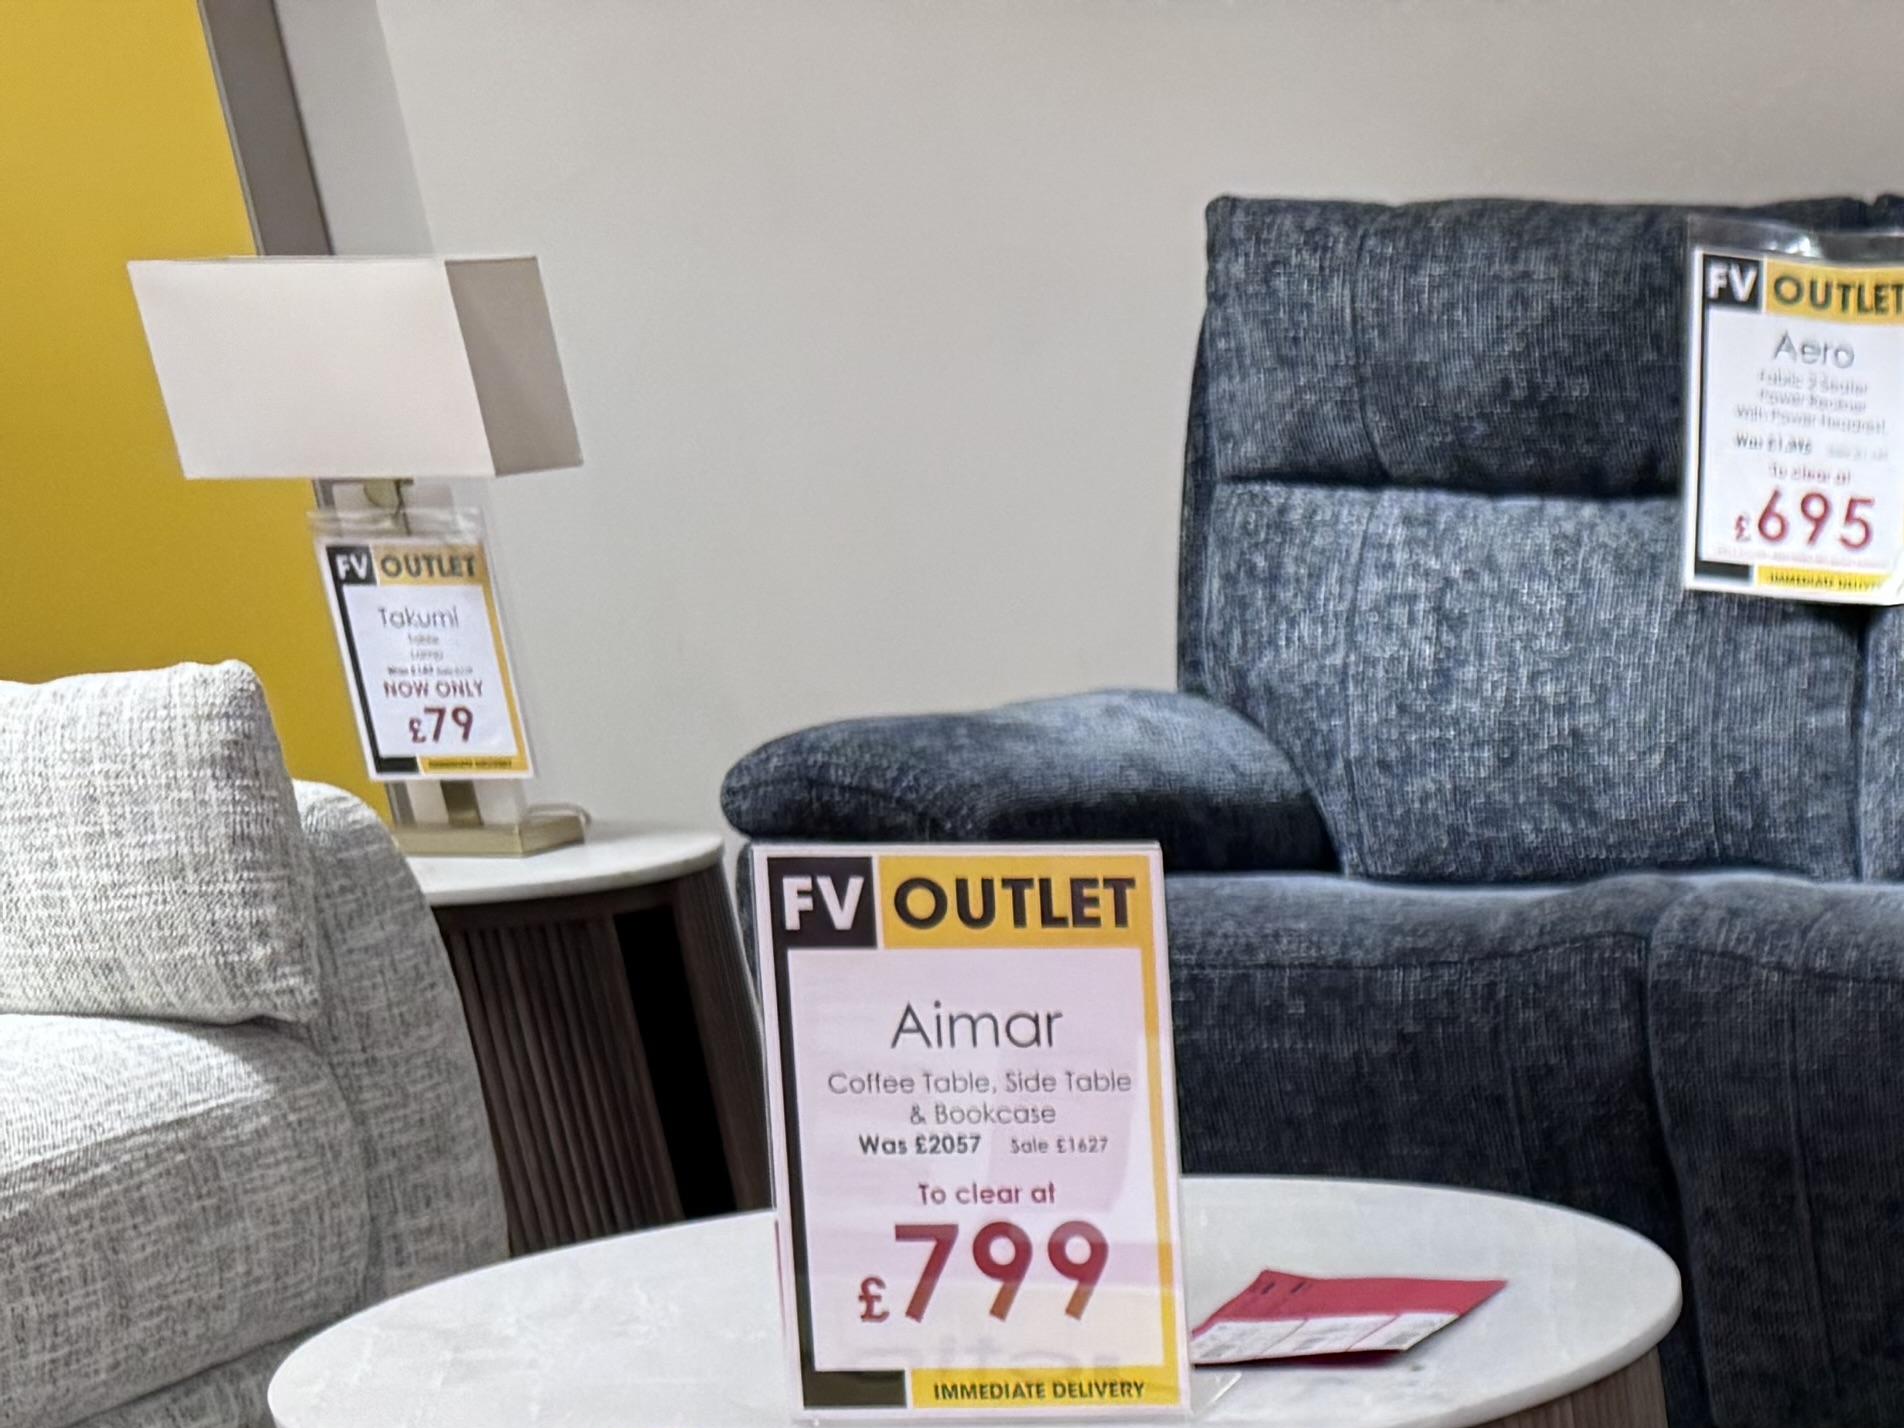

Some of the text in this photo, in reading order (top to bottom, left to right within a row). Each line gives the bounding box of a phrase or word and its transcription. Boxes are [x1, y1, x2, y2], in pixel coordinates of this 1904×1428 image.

[1706, 264, 1757, 302] FV
[1773, 330, 1855, 369] Aero
[1734, 489, 1875, 551] £695
[335, 554, 476, 580] FV OUTLET
[378, 606, 460, 628] Takumi
[383, 680, 483, 698] NOW ONLY
[408, 705, 474, 744] £79
[782, 874, 1137, 931] FV OUTLET
[890, 1001, 1064, 1050] Aimar
[827, 1070, 1132, 1096] Coffee Table, Side Table
[910, 1103, 1057, 1124] & Bookcase
[858, 1135, 1109, 1155] Was £2057 Sale £1627
[917, 1181, 1056, 1204] To clear at
[858, 1220, 1110, 1323] £799
[933, 1380, 1146, 1401] IMMEDIATE DELIVERY
